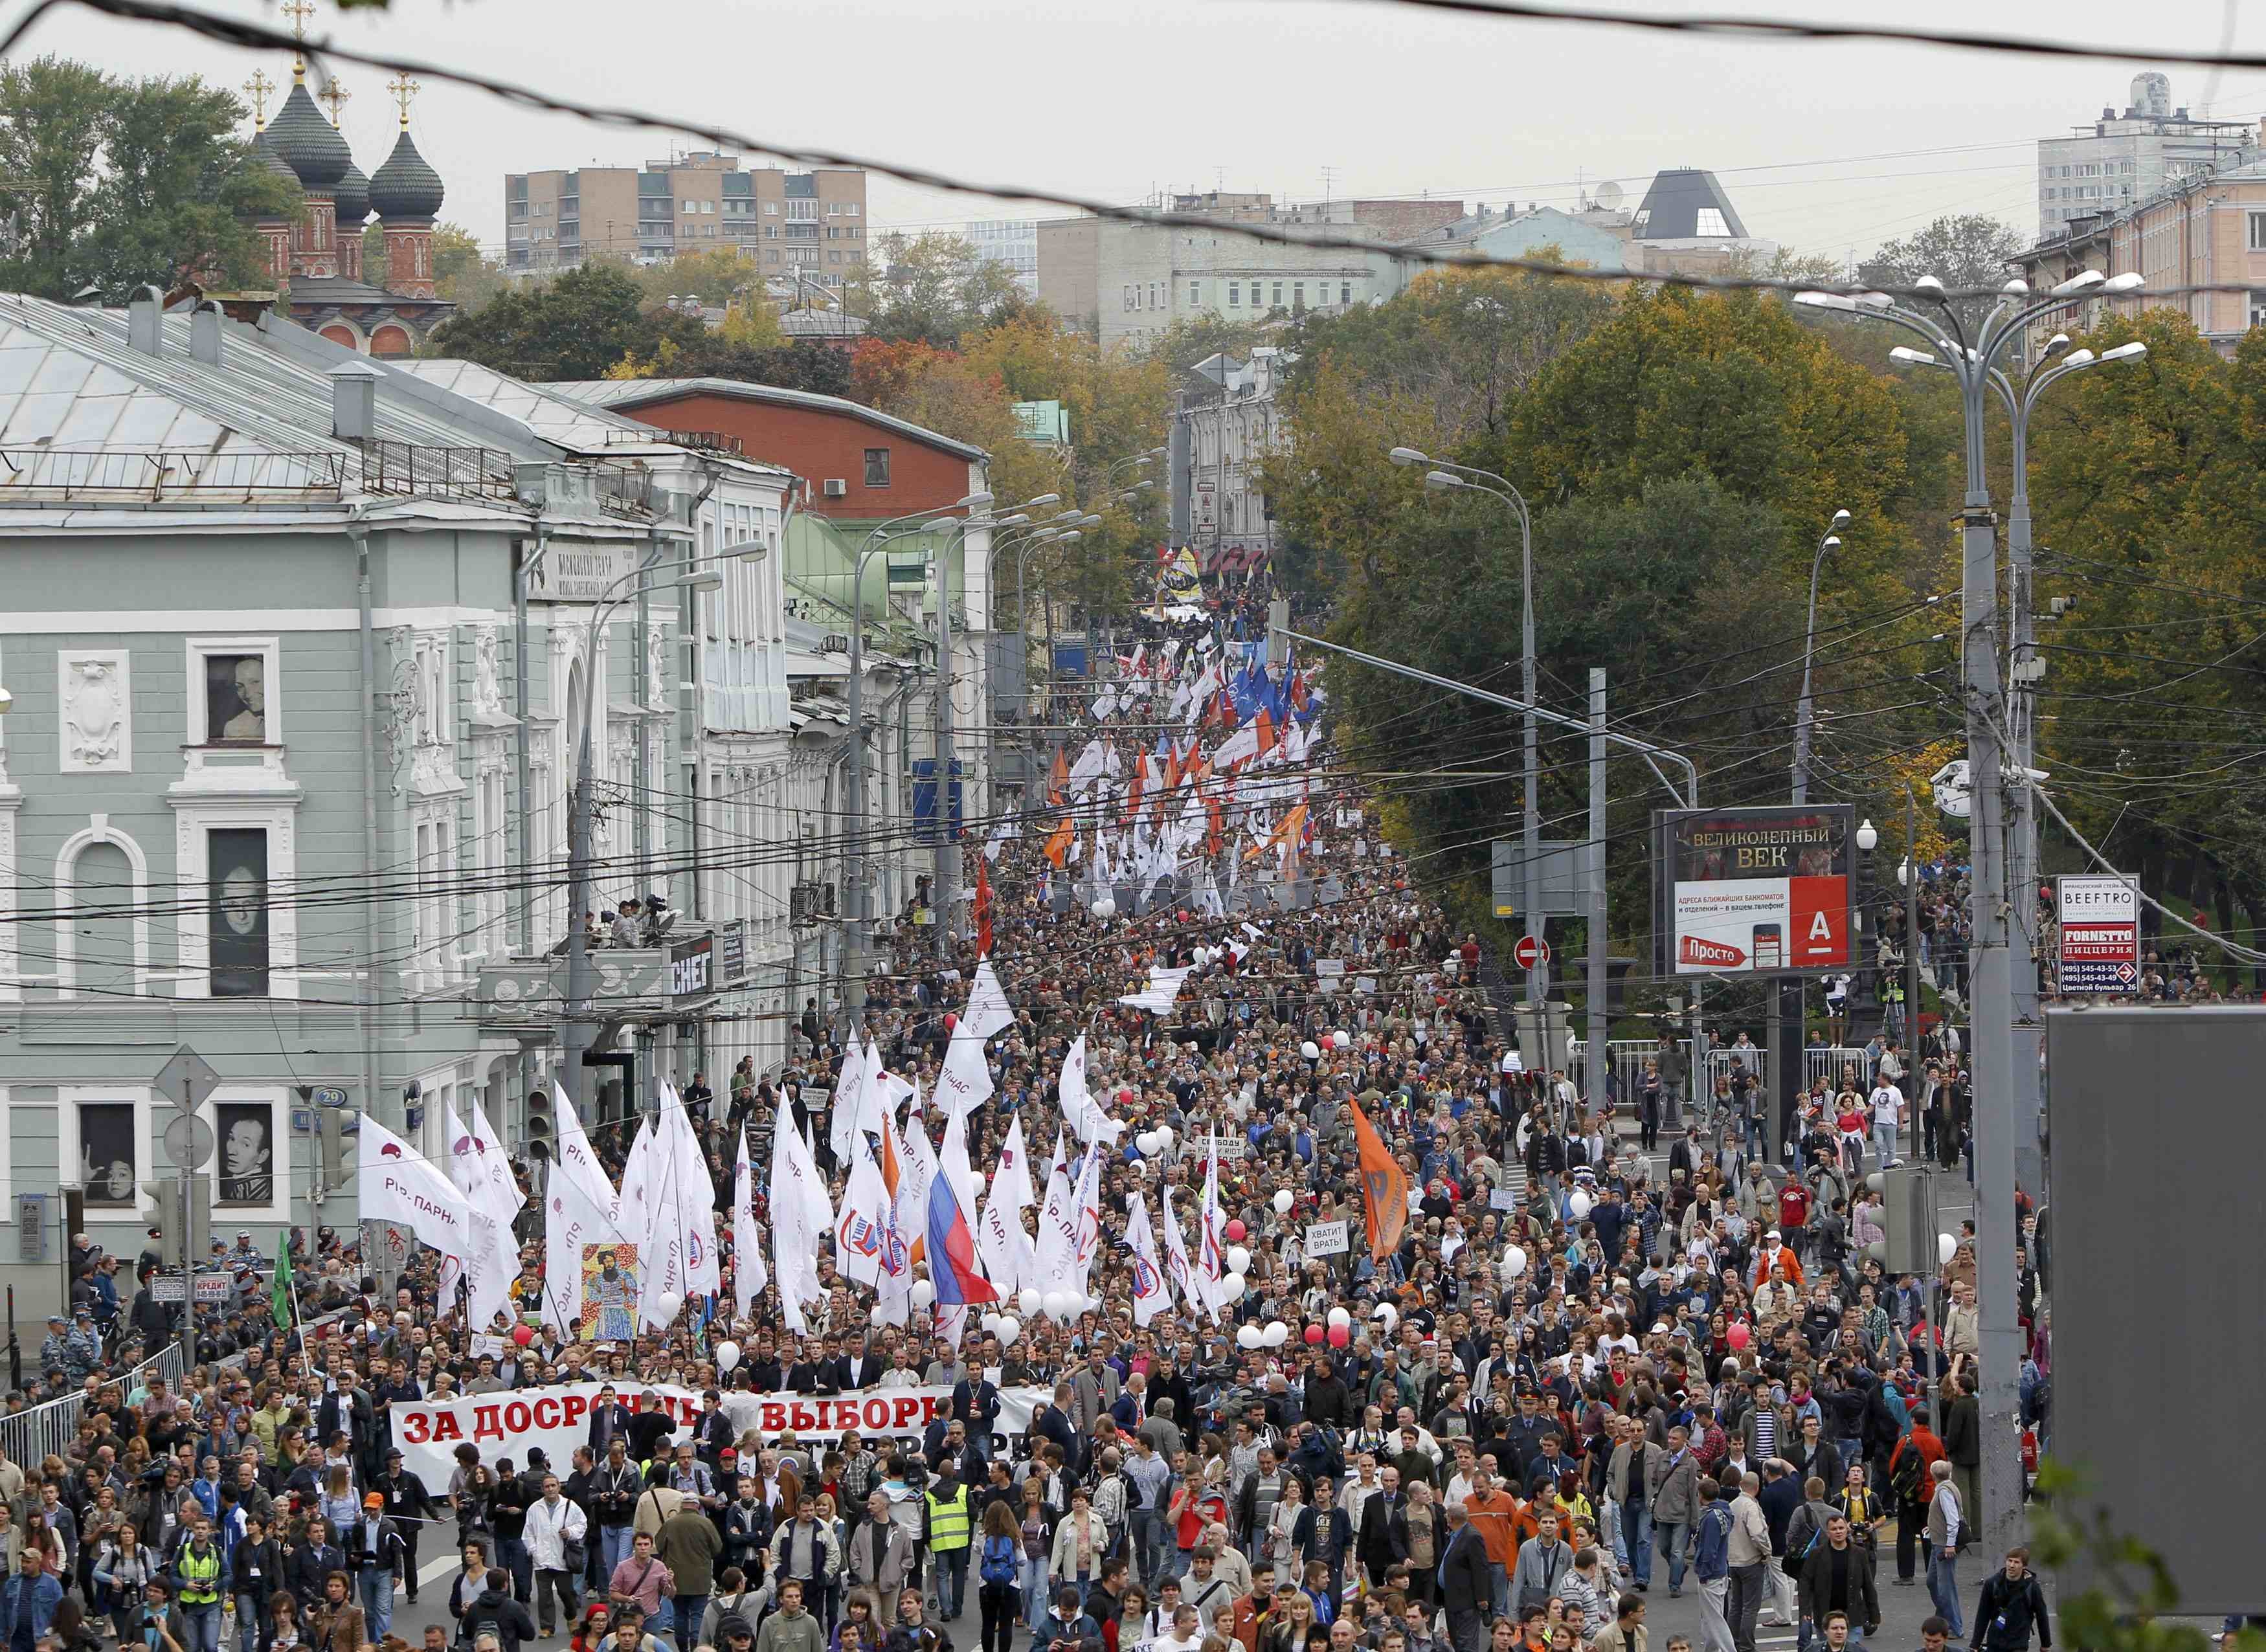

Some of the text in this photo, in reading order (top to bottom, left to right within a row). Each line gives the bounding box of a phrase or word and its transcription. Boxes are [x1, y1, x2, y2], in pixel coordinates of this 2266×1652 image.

[1694, 829, 1829, 846] ВЕЛИКОЛЕПНЫЙ
[1736, 846, 1788, 869] ВЕК
[1703, 894, 1744, 903] БЛИЖАЙШИХ
[1745, 893, 1784, 901] БАНКОМАТОВ
[2065, 893, 2131, 904] BEEFTRO
[1685, 905, 1718, 913] отделений
[1754, 903, 1784, 911] телефоне
[2065, 930, 2132, 942] FORNETTO
[1690, 939, 1734, 961] Просто
[323, 1092, 338, 1102] 29
[1813, 1095, 1823, 1104] 92
[1311, 1227, 1342, 1238] ХВАТИТ
[1314, 1238, 1342, 1249] ВРАТЬ!
[403, 1411, 463, 1444] ЗА
